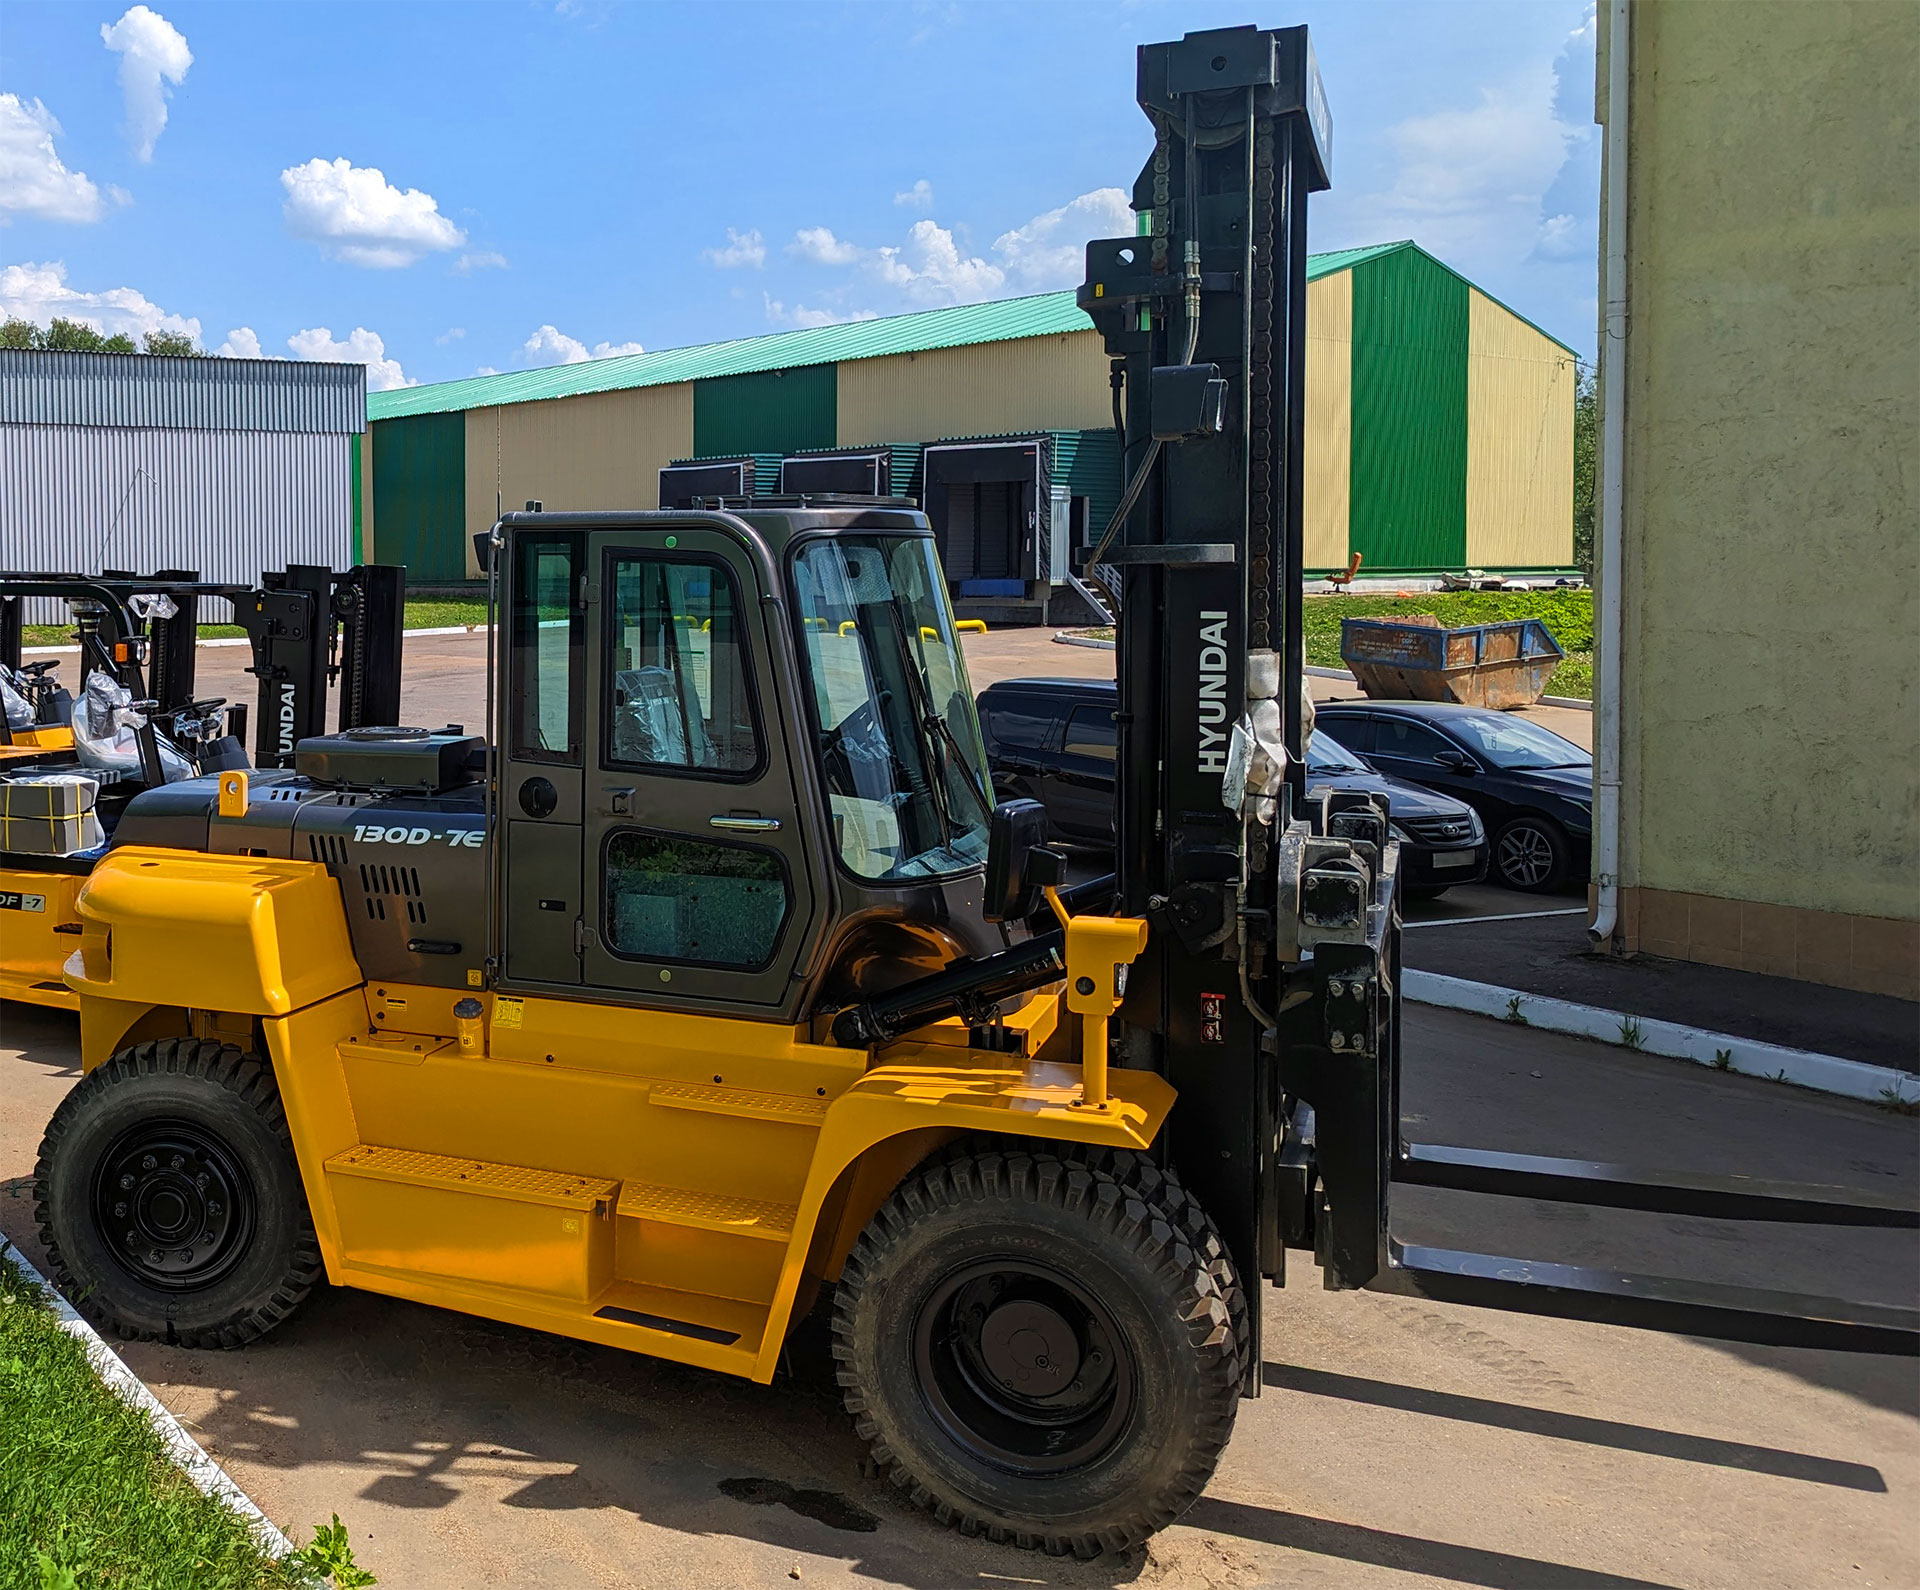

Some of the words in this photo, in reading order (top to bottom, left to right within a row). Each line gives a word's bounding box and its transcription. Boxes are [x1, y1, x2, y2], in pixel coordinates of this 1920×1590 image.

[279, 683, 295, 768] UNDAI
[1198, 611, 1228, 773] HYUNDAI
[353, 825, 486, 848] 130D-7E
